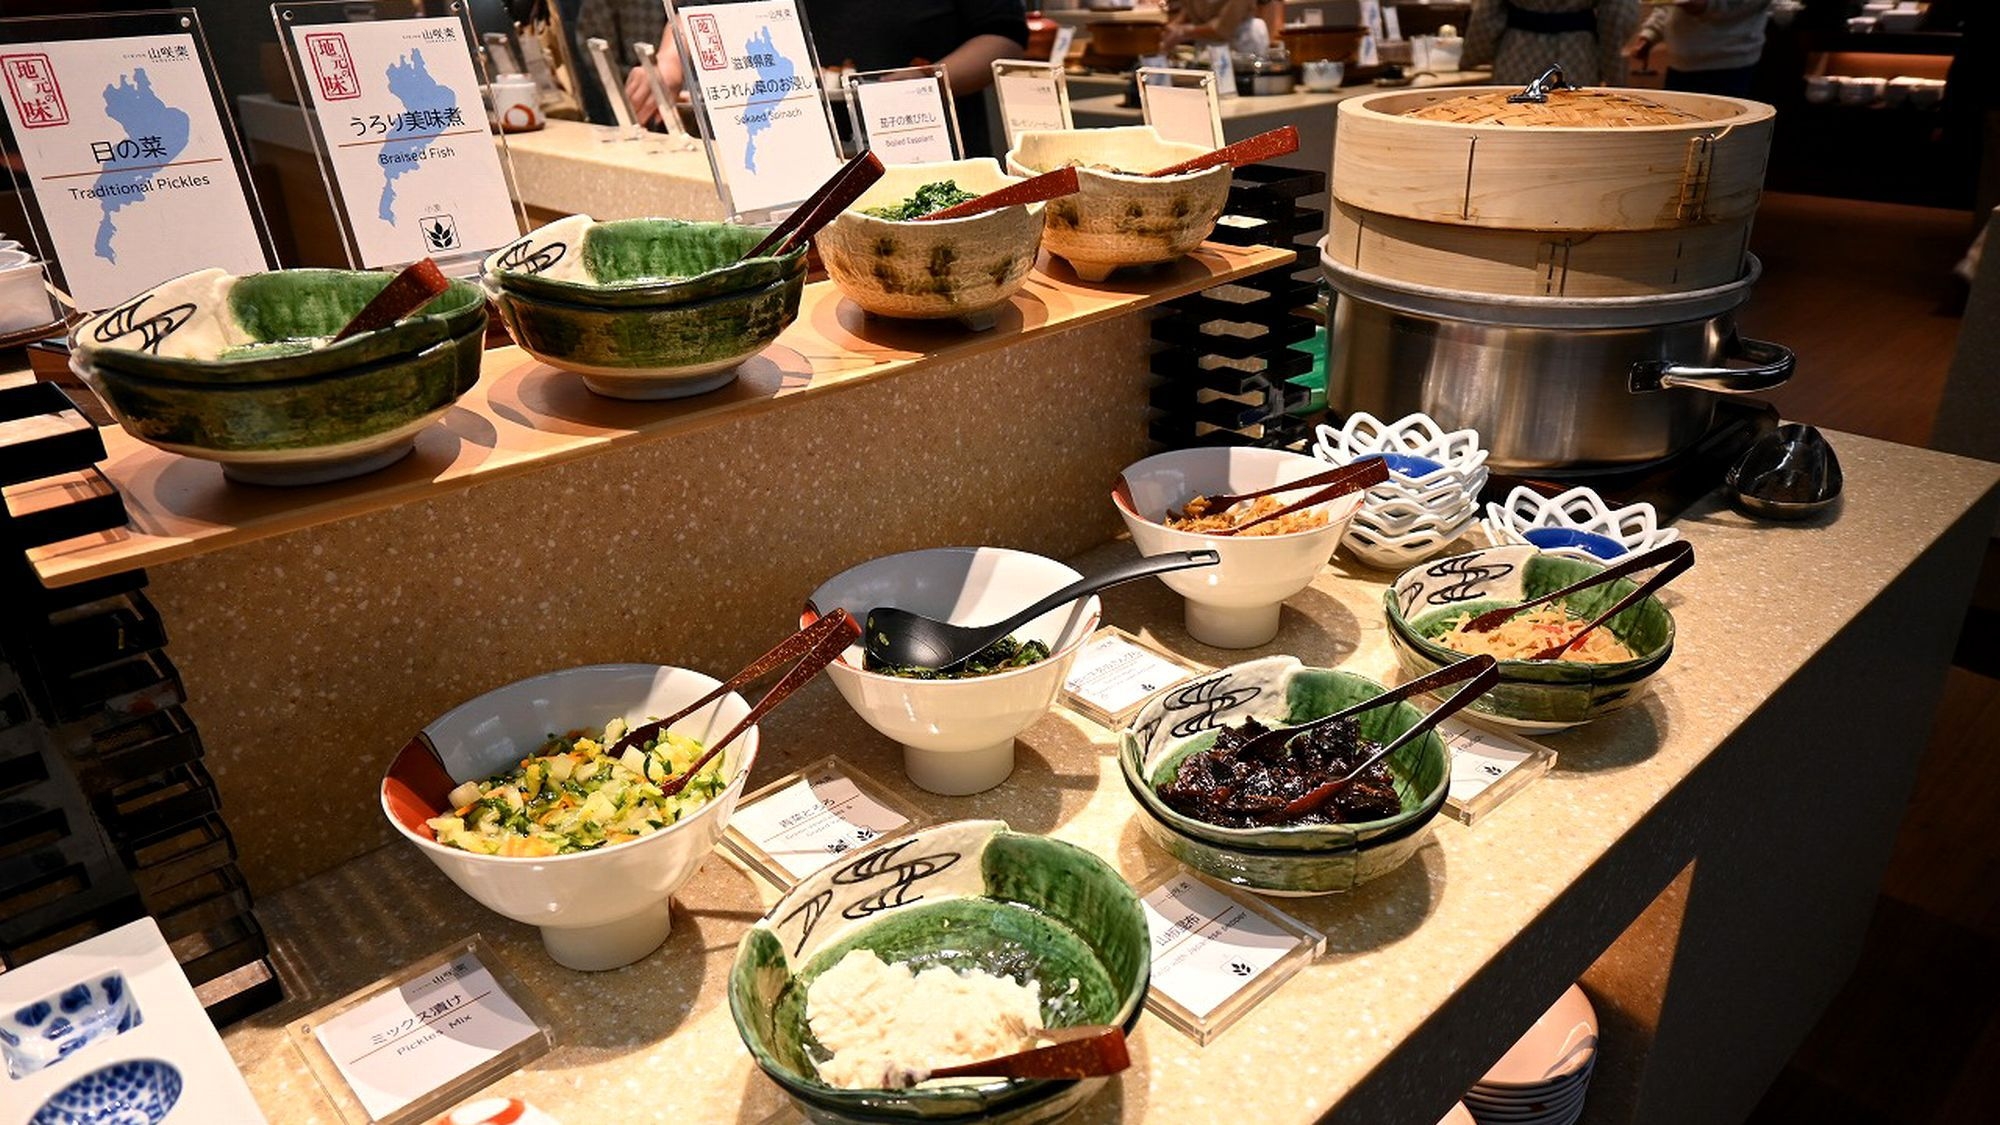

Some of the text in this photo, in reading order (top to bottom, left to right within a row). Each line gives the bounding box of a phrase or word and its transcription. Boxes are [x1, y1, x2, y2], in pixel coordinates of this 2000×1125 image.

[318, 40, 351, 95] 地元の味
[731, 53, 776, 71] 滋賀県産
[16, 60, 54, 121] 地元の味
[705, 76, 813, 101] ほうれん草のお浸し
[350, 107, 466, 137] うろり美味煮
[90, 136, 167, 164] 日の菜
[379, 147, 456, 166] Braised Fish
[68, 174, 210, 200] Traditional Pickles
[371, 995, 462, 1045] ミックス漬け
[396, 1013, 472, 1056] Pickles Mix
